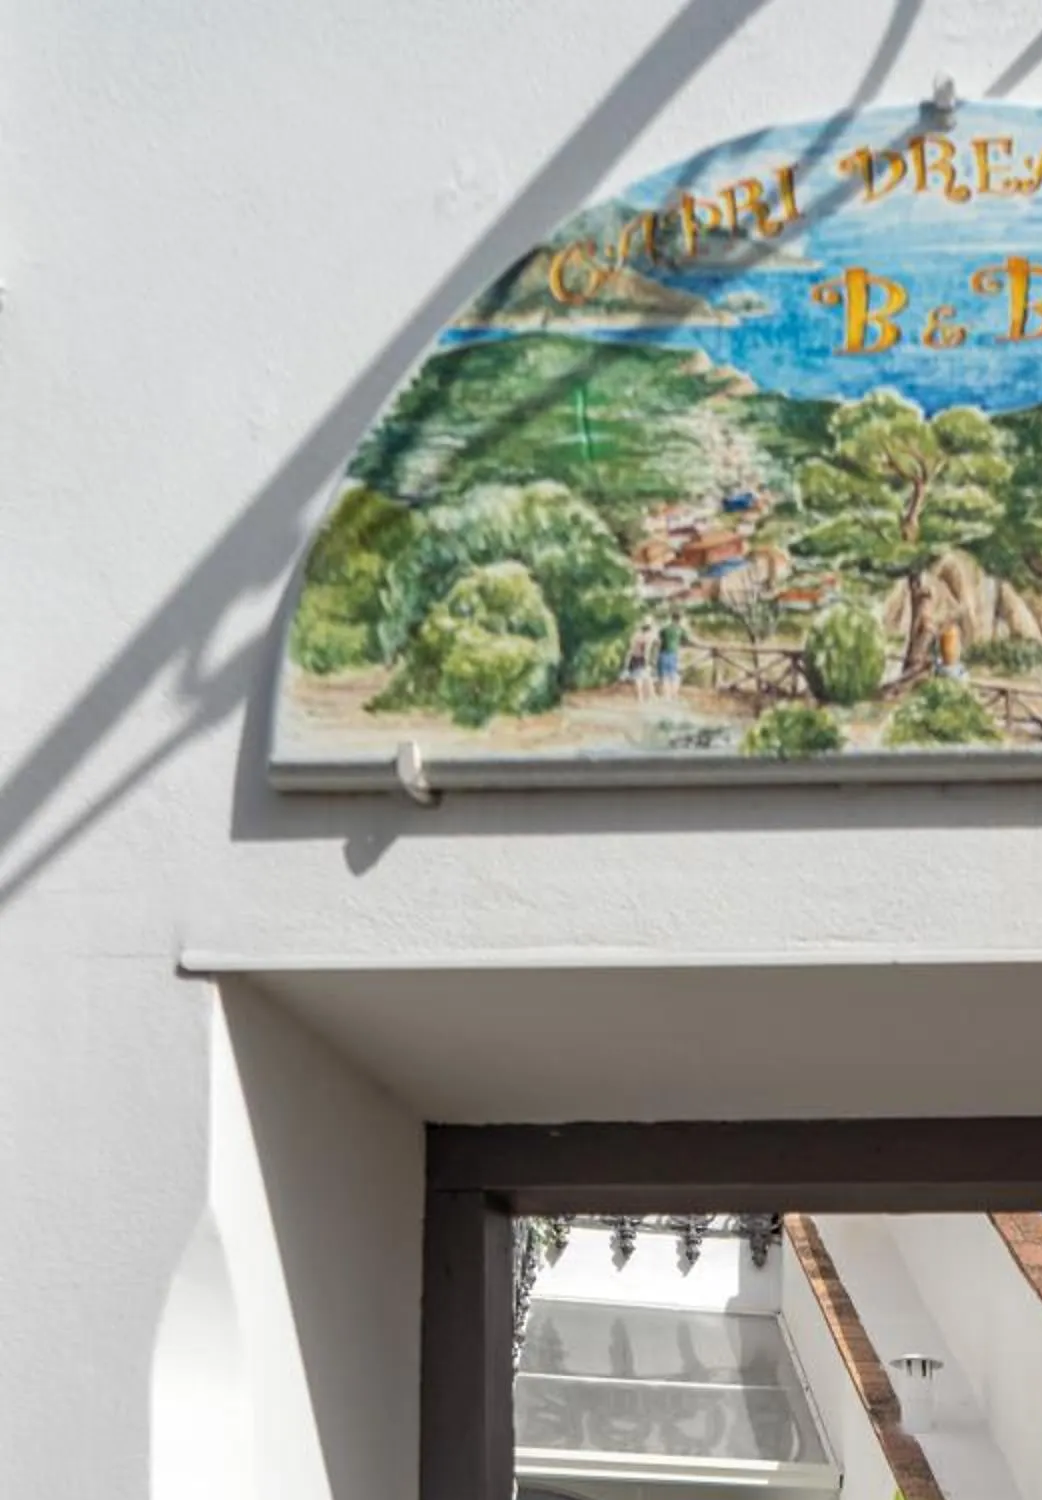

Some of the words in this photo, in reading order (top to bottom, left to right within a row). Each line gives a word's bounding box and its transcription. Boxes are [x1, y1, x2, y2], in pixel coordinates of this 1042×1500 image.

[548, 162, 804, 305] CAPRI
[811, 266, 908, 356] B
[922, 305, 966, 350] &
